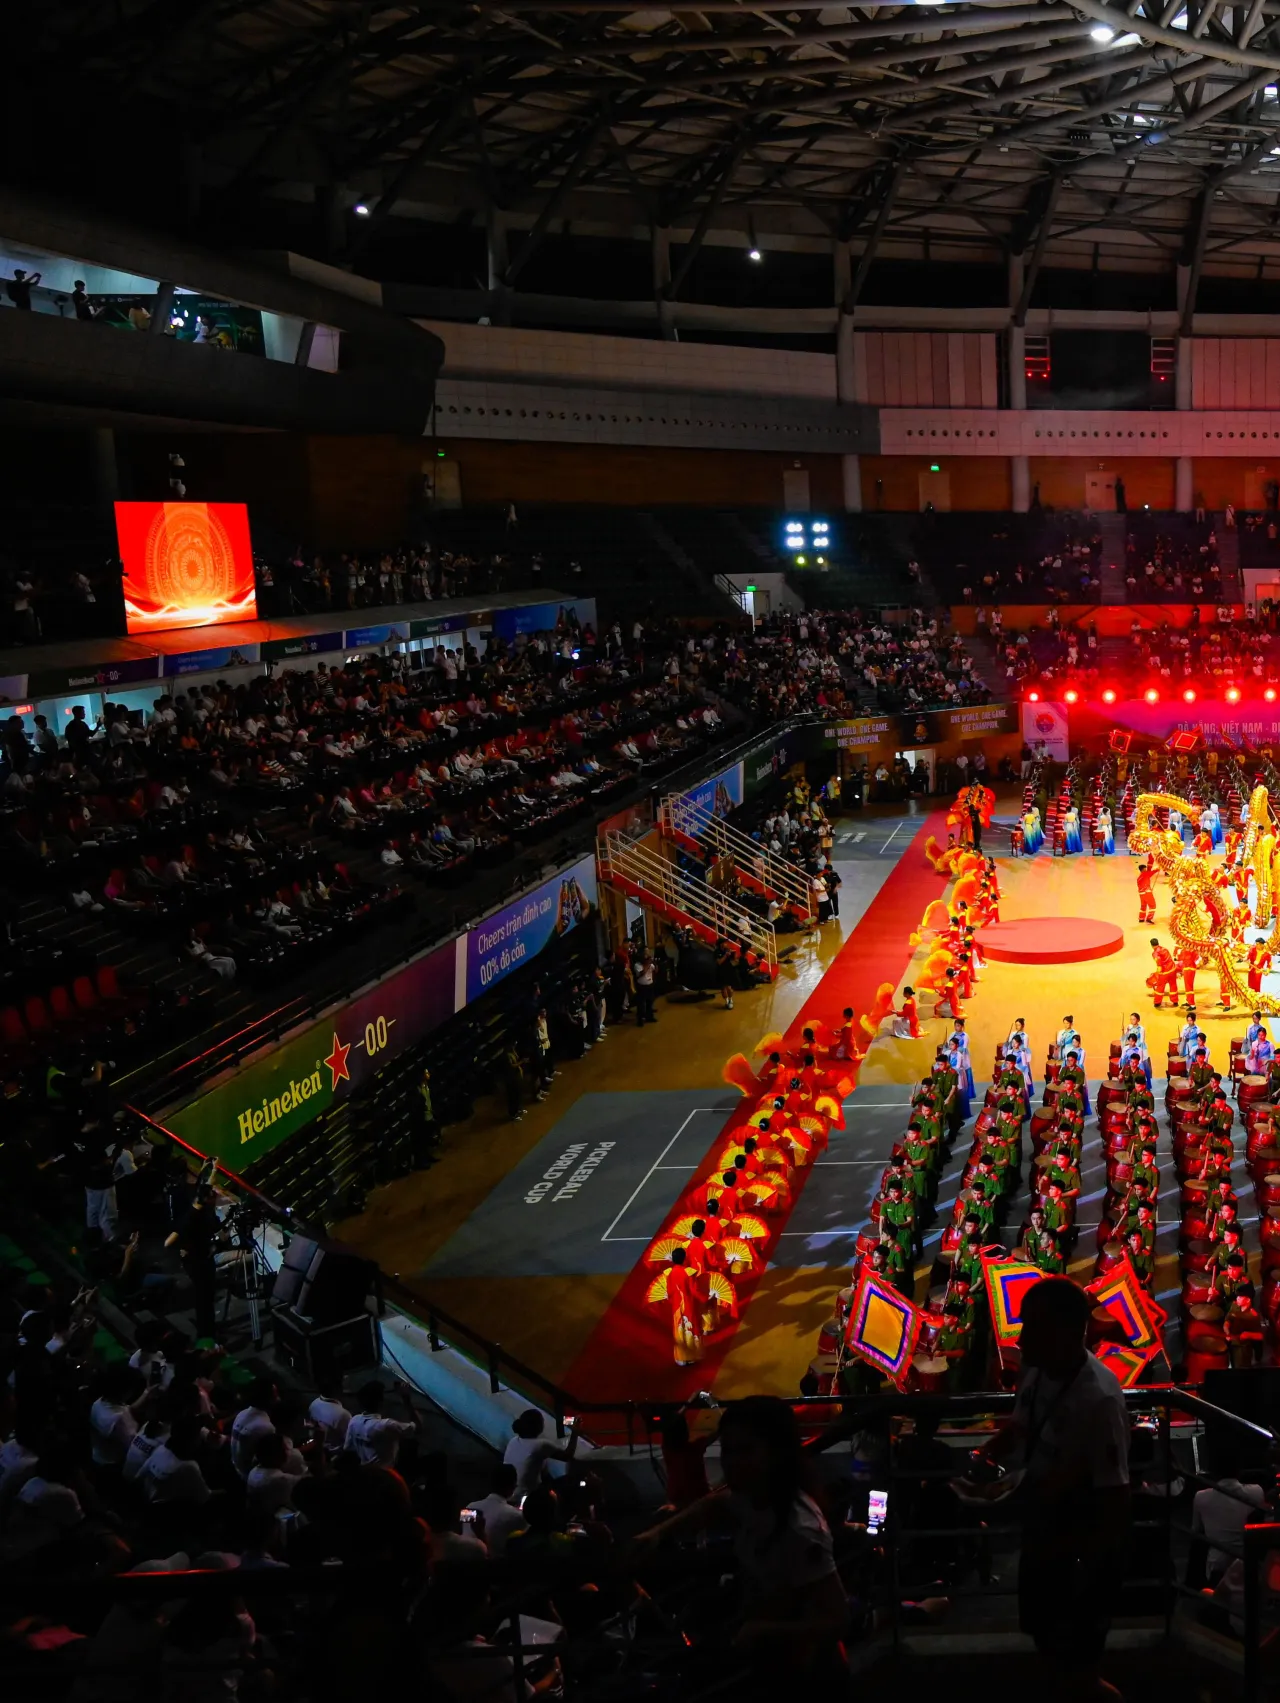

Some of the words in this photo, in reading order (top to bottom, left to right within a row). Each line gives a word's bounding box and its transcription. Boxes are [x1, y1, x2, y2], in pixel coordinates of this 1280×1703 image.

[1242, 722, 1263, 734] NAM
[478, 926, 506, 955] Cheers
[539, 896, 552, 915] cao
[542, 1142, 589, 1180] WORLD
[551, 1141, 617, 1202] PICKLEBALL
[523, 1181, 554, 1204] CUP
